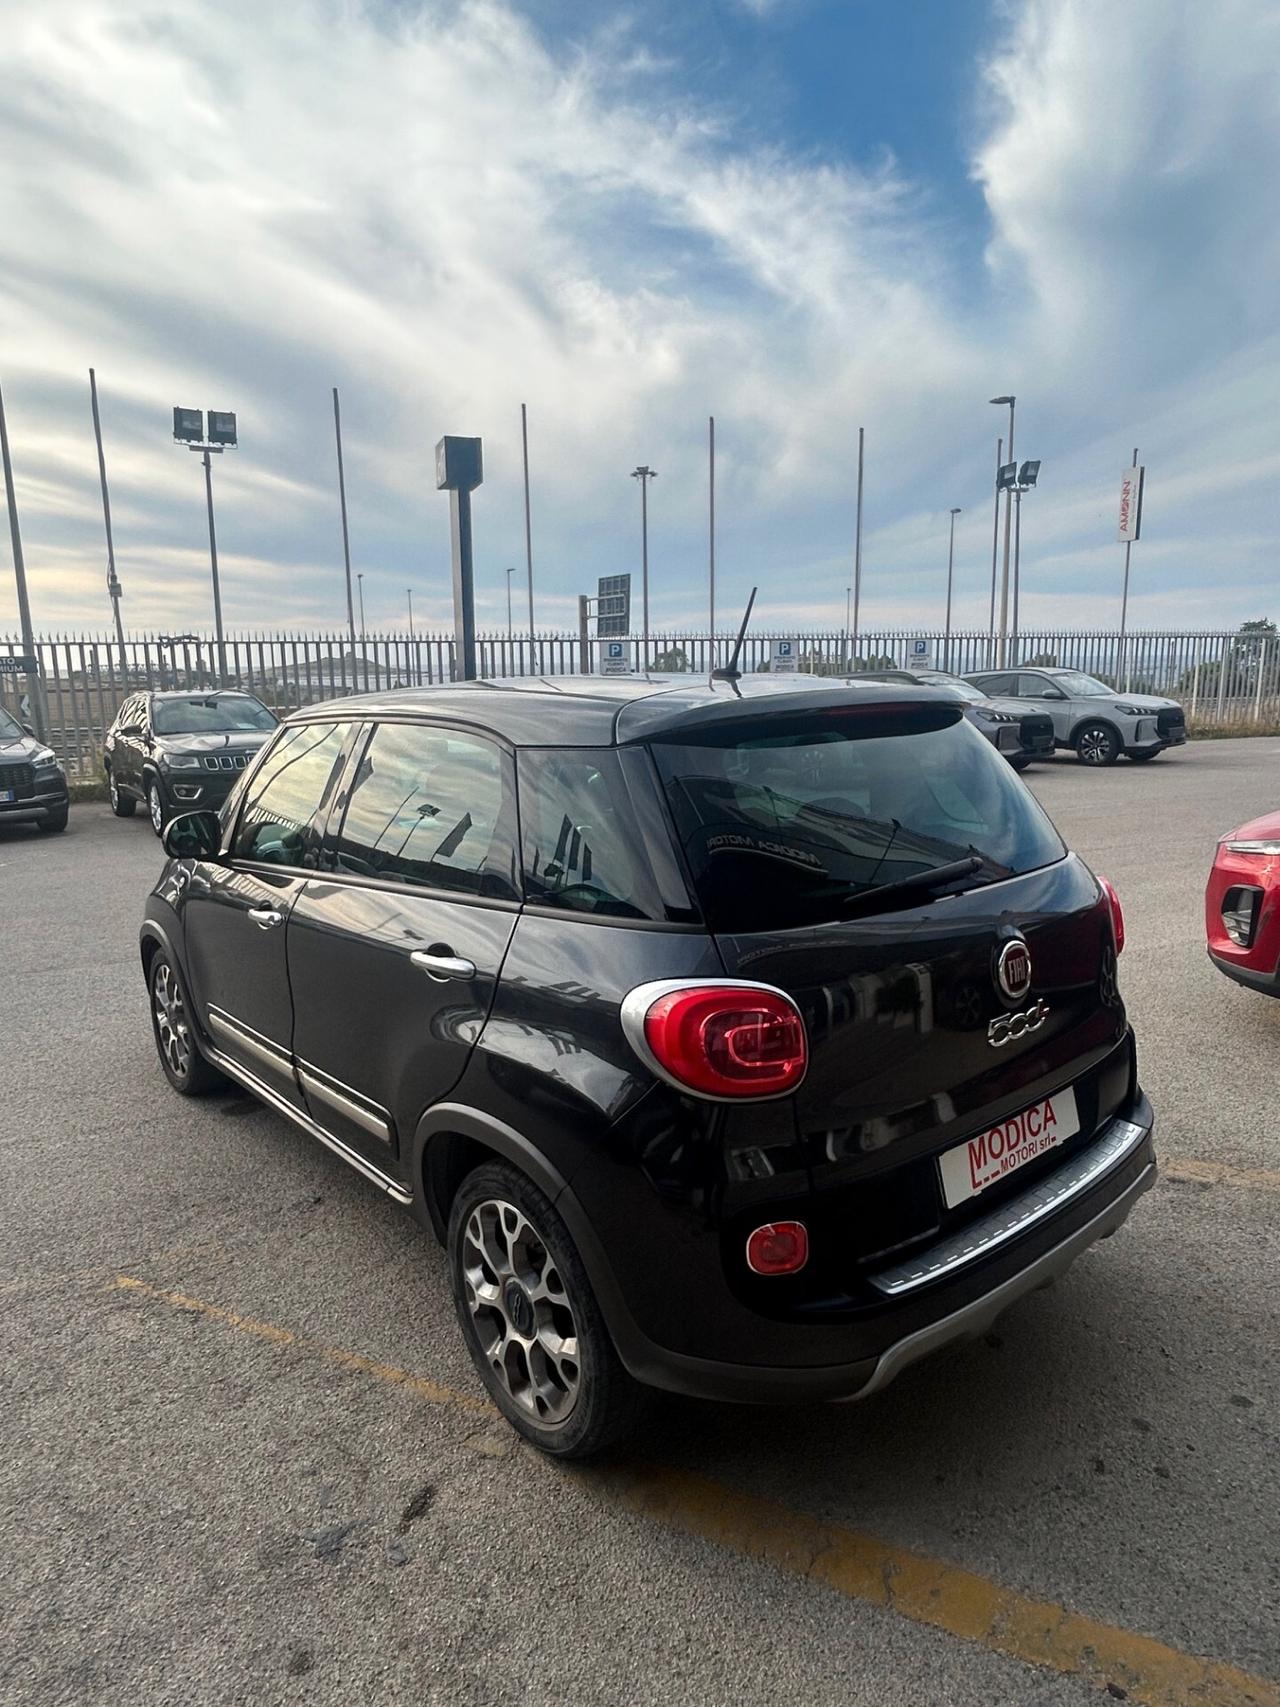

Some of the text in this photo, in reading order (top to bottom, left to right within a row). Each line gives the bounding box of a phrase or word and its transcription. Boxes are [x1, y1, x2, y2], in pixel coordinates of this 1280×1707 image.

[1008, 955, 1025, 984] FIAT
[968, 1099, 1057, 1170] MODICA
[1001, 1140, 1038, 1174] MOTORI
